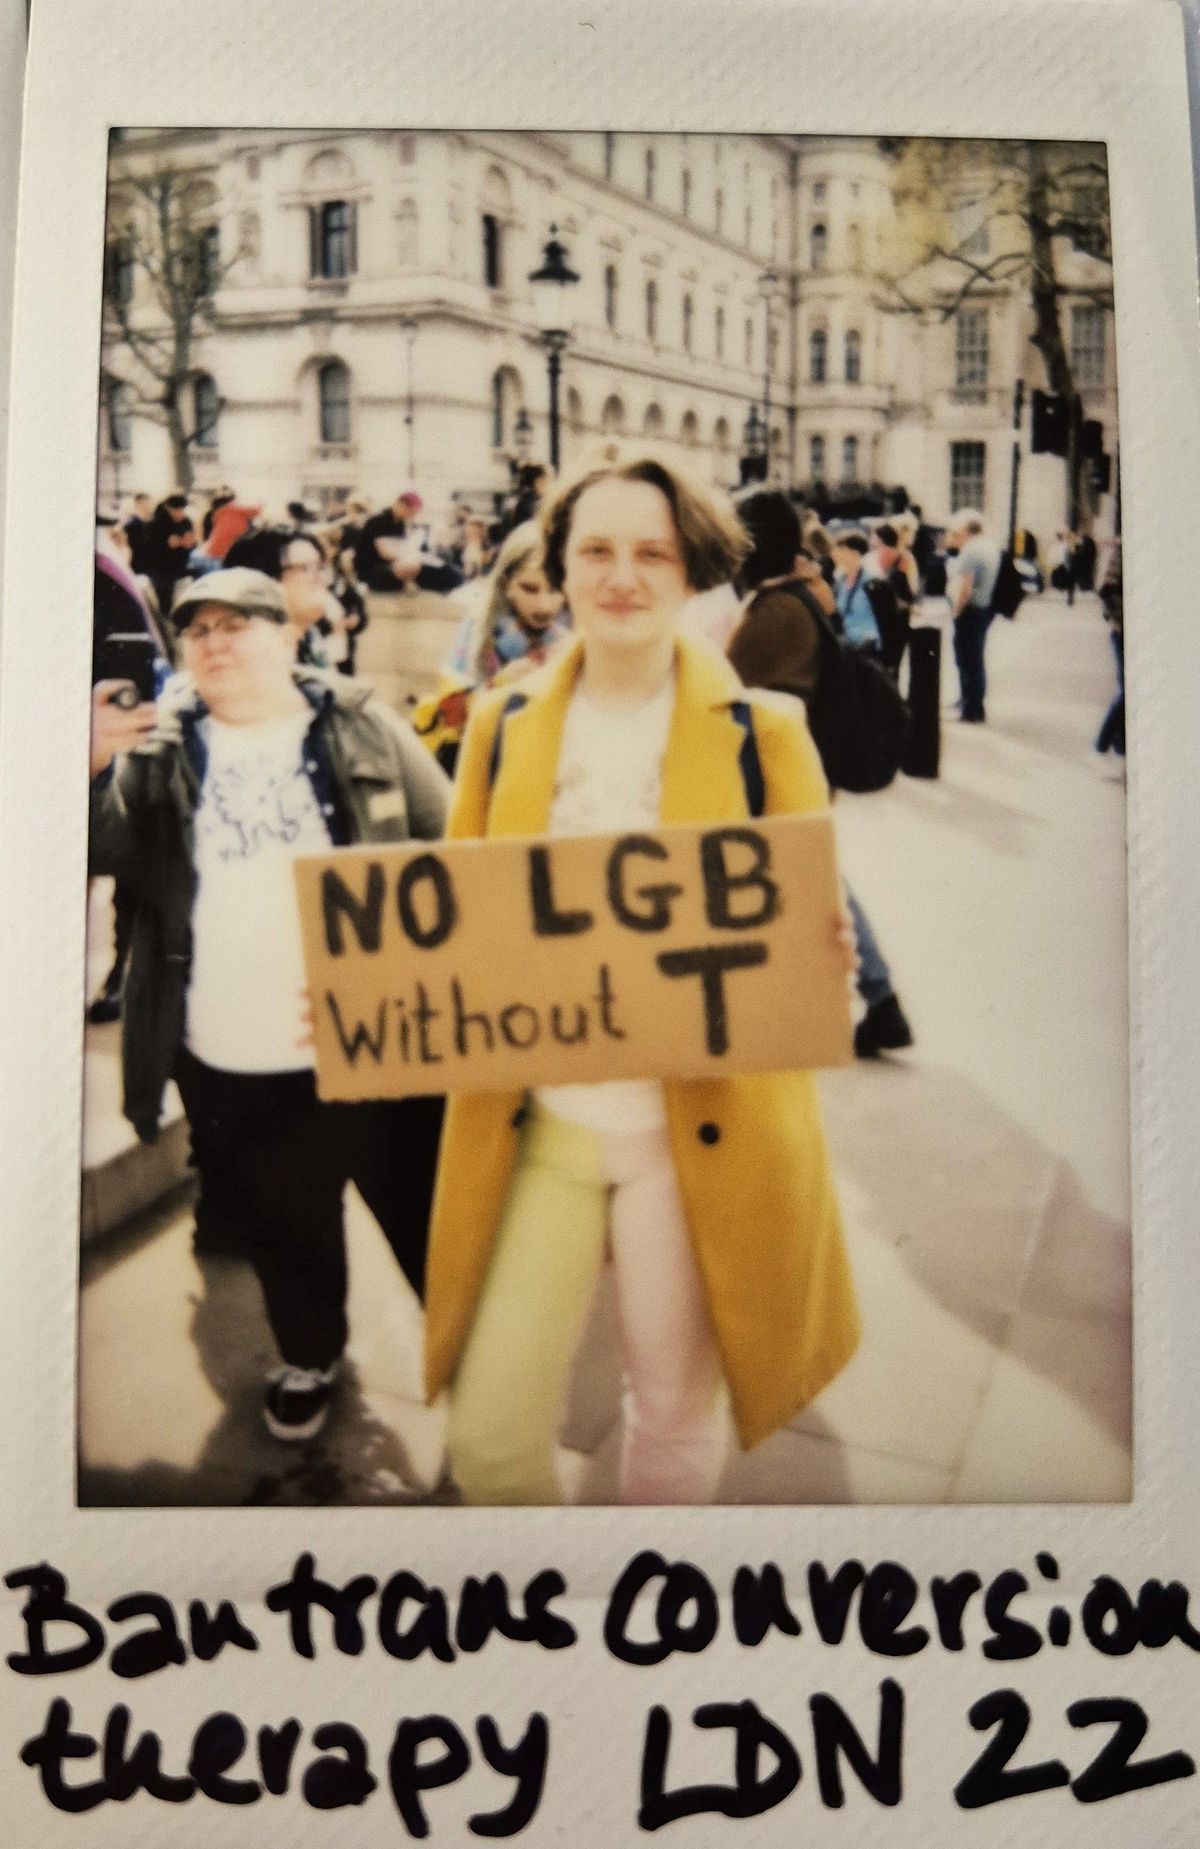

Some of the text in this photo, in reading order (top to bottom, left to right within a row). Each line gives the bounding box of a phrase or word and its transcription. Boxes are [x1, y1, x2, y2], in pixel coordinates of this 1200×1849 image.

[321, 827, 780, 957] NO LGB
[656, 941, 769, 1057] T
[4, 1562, 259, 1678] Ban
[266, 1551, 577, 1663] trans
[20, 1677, 1195, 1839] therapy LDN 22
